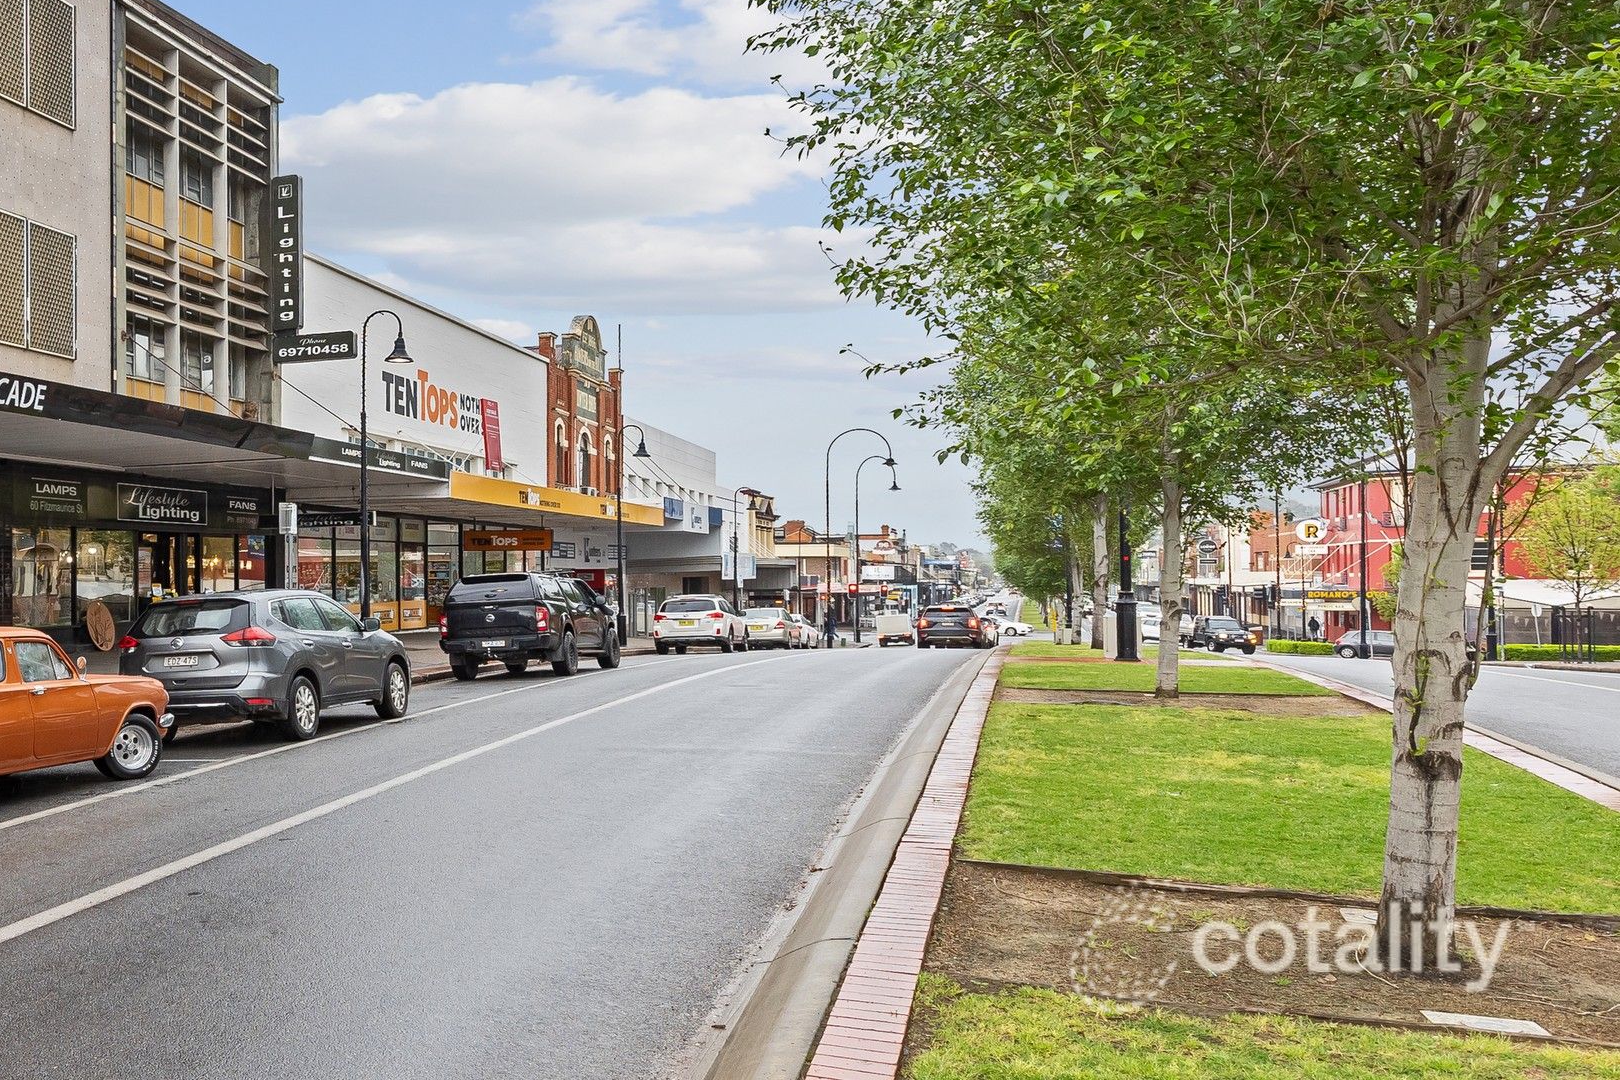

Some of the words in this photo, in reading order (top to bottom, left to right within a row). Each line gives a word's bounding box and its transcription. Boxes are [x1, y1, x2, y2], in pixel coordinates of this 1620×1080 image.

[277, 206, 294, 321] Lighting
[278, 343, 349, 357] 69710458
[410, 461, 429, 469] FANS
[36, 483, 77, 496] LAMPS
[123, 486, 189, 508] Lifestyle
[30, 500, 39, 510] 60
[229, 500, 257, 510] FANS
[138, 504, 200, 521] Lighting
[1307, 591, 1357, 599] ROMANO'S
